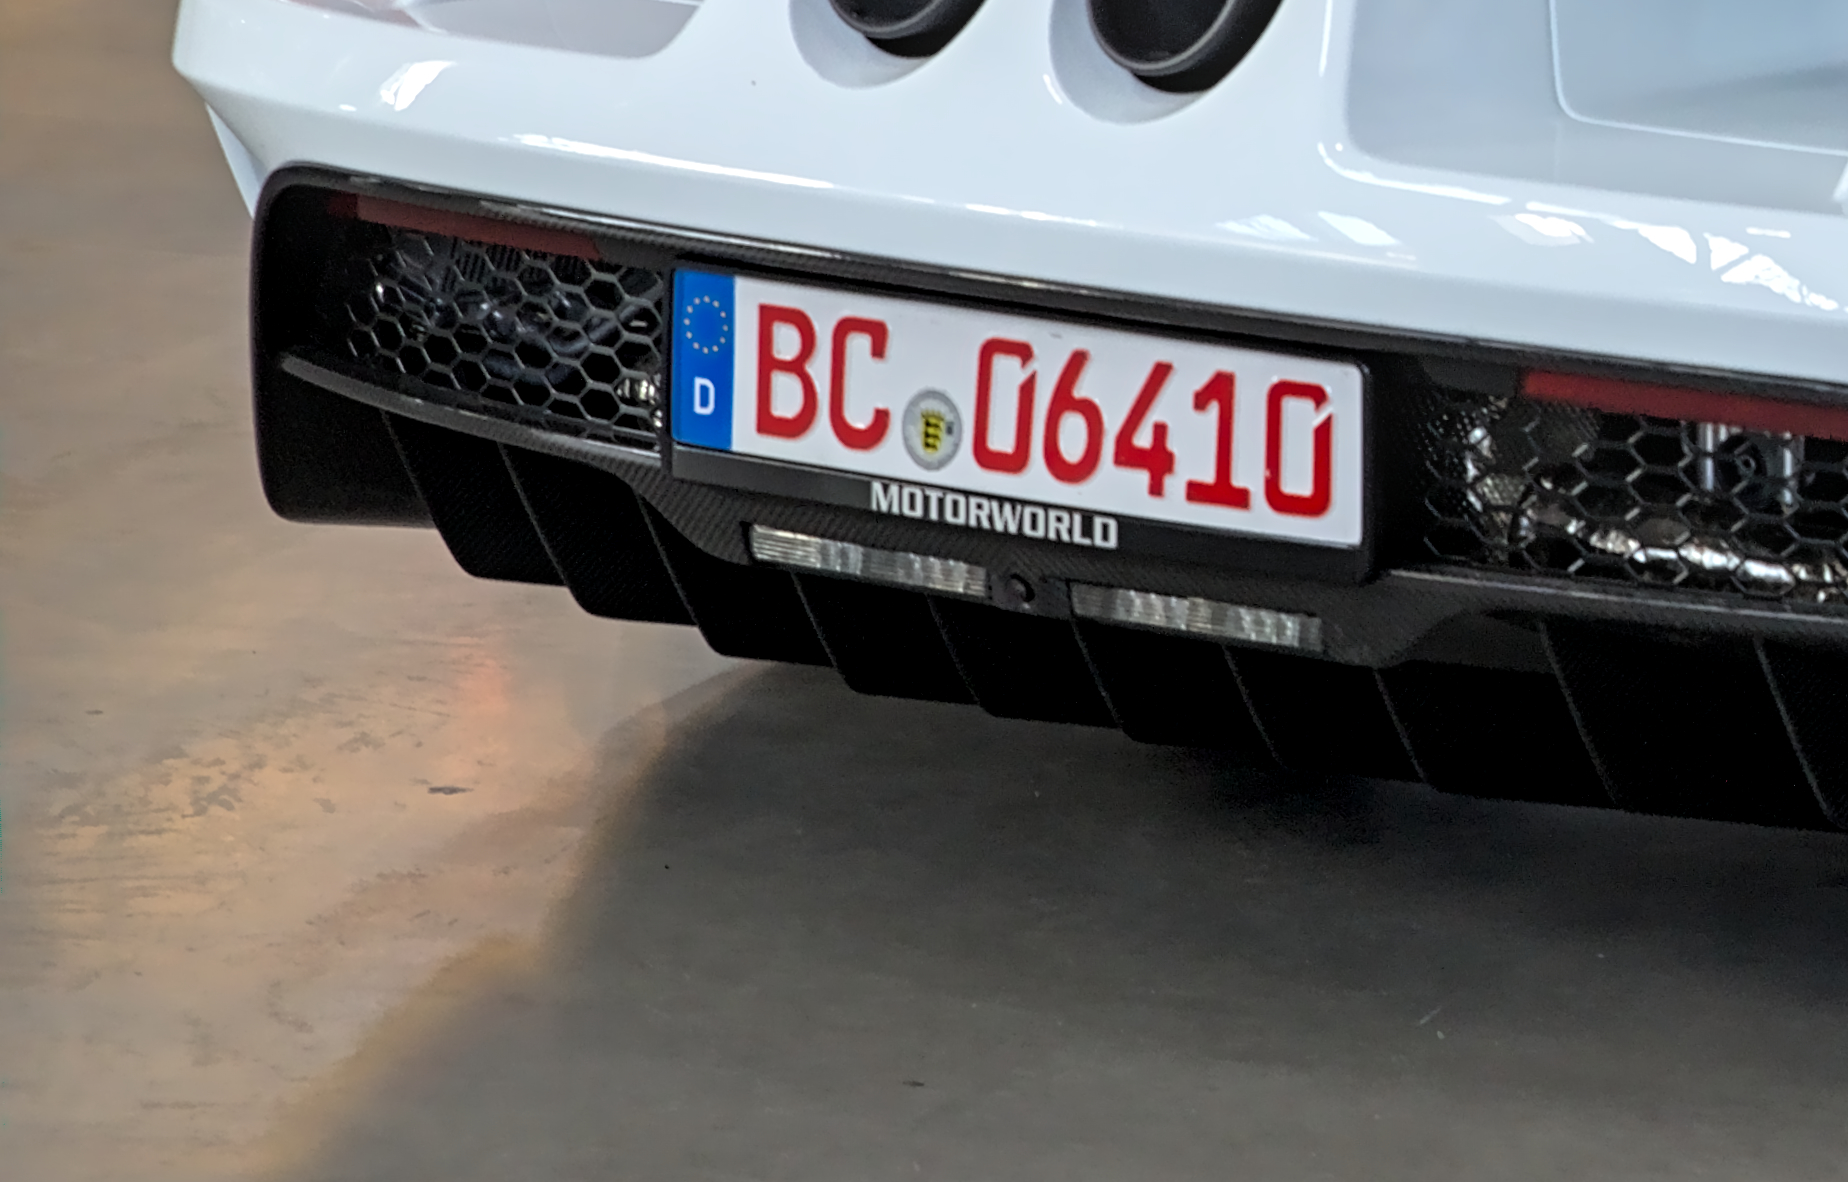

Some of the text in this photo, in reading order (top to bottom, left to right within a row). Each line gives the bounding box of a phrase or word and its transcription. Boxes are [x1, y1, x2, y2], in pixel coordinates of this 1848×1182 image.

[692, 376, 716, 416] D
[755, 303, 1336, 520] BC 06410
[869, 480, 1119, 551] MOTORWORLD
